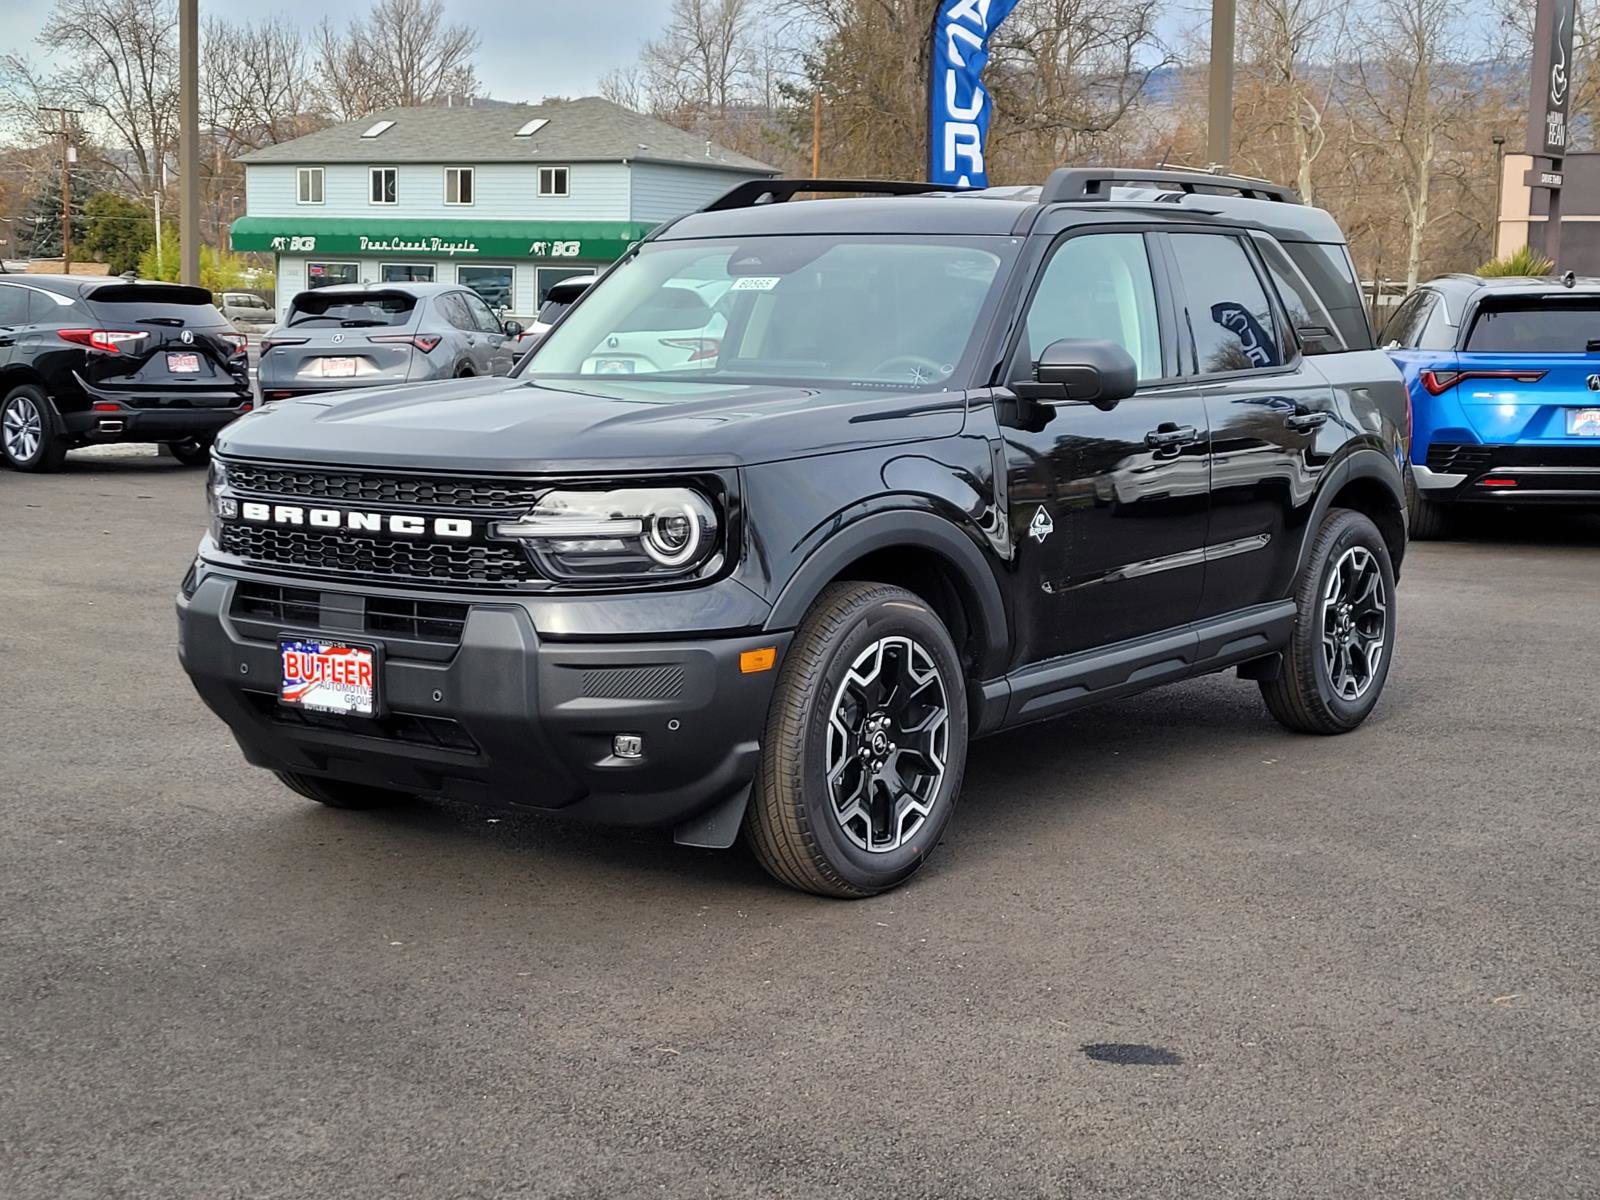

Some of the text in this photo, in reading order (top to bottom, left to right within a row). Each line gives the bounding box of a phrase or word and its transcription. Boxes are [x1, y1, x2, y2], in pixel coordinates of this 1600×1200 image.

[945, 0, 990, 187] ACUR
[360, 237, 480, 256] Bear Creek Bicycle
[242, 502, 472, 538] BRONCO
[285, 652, 372, 686] BUTLER
